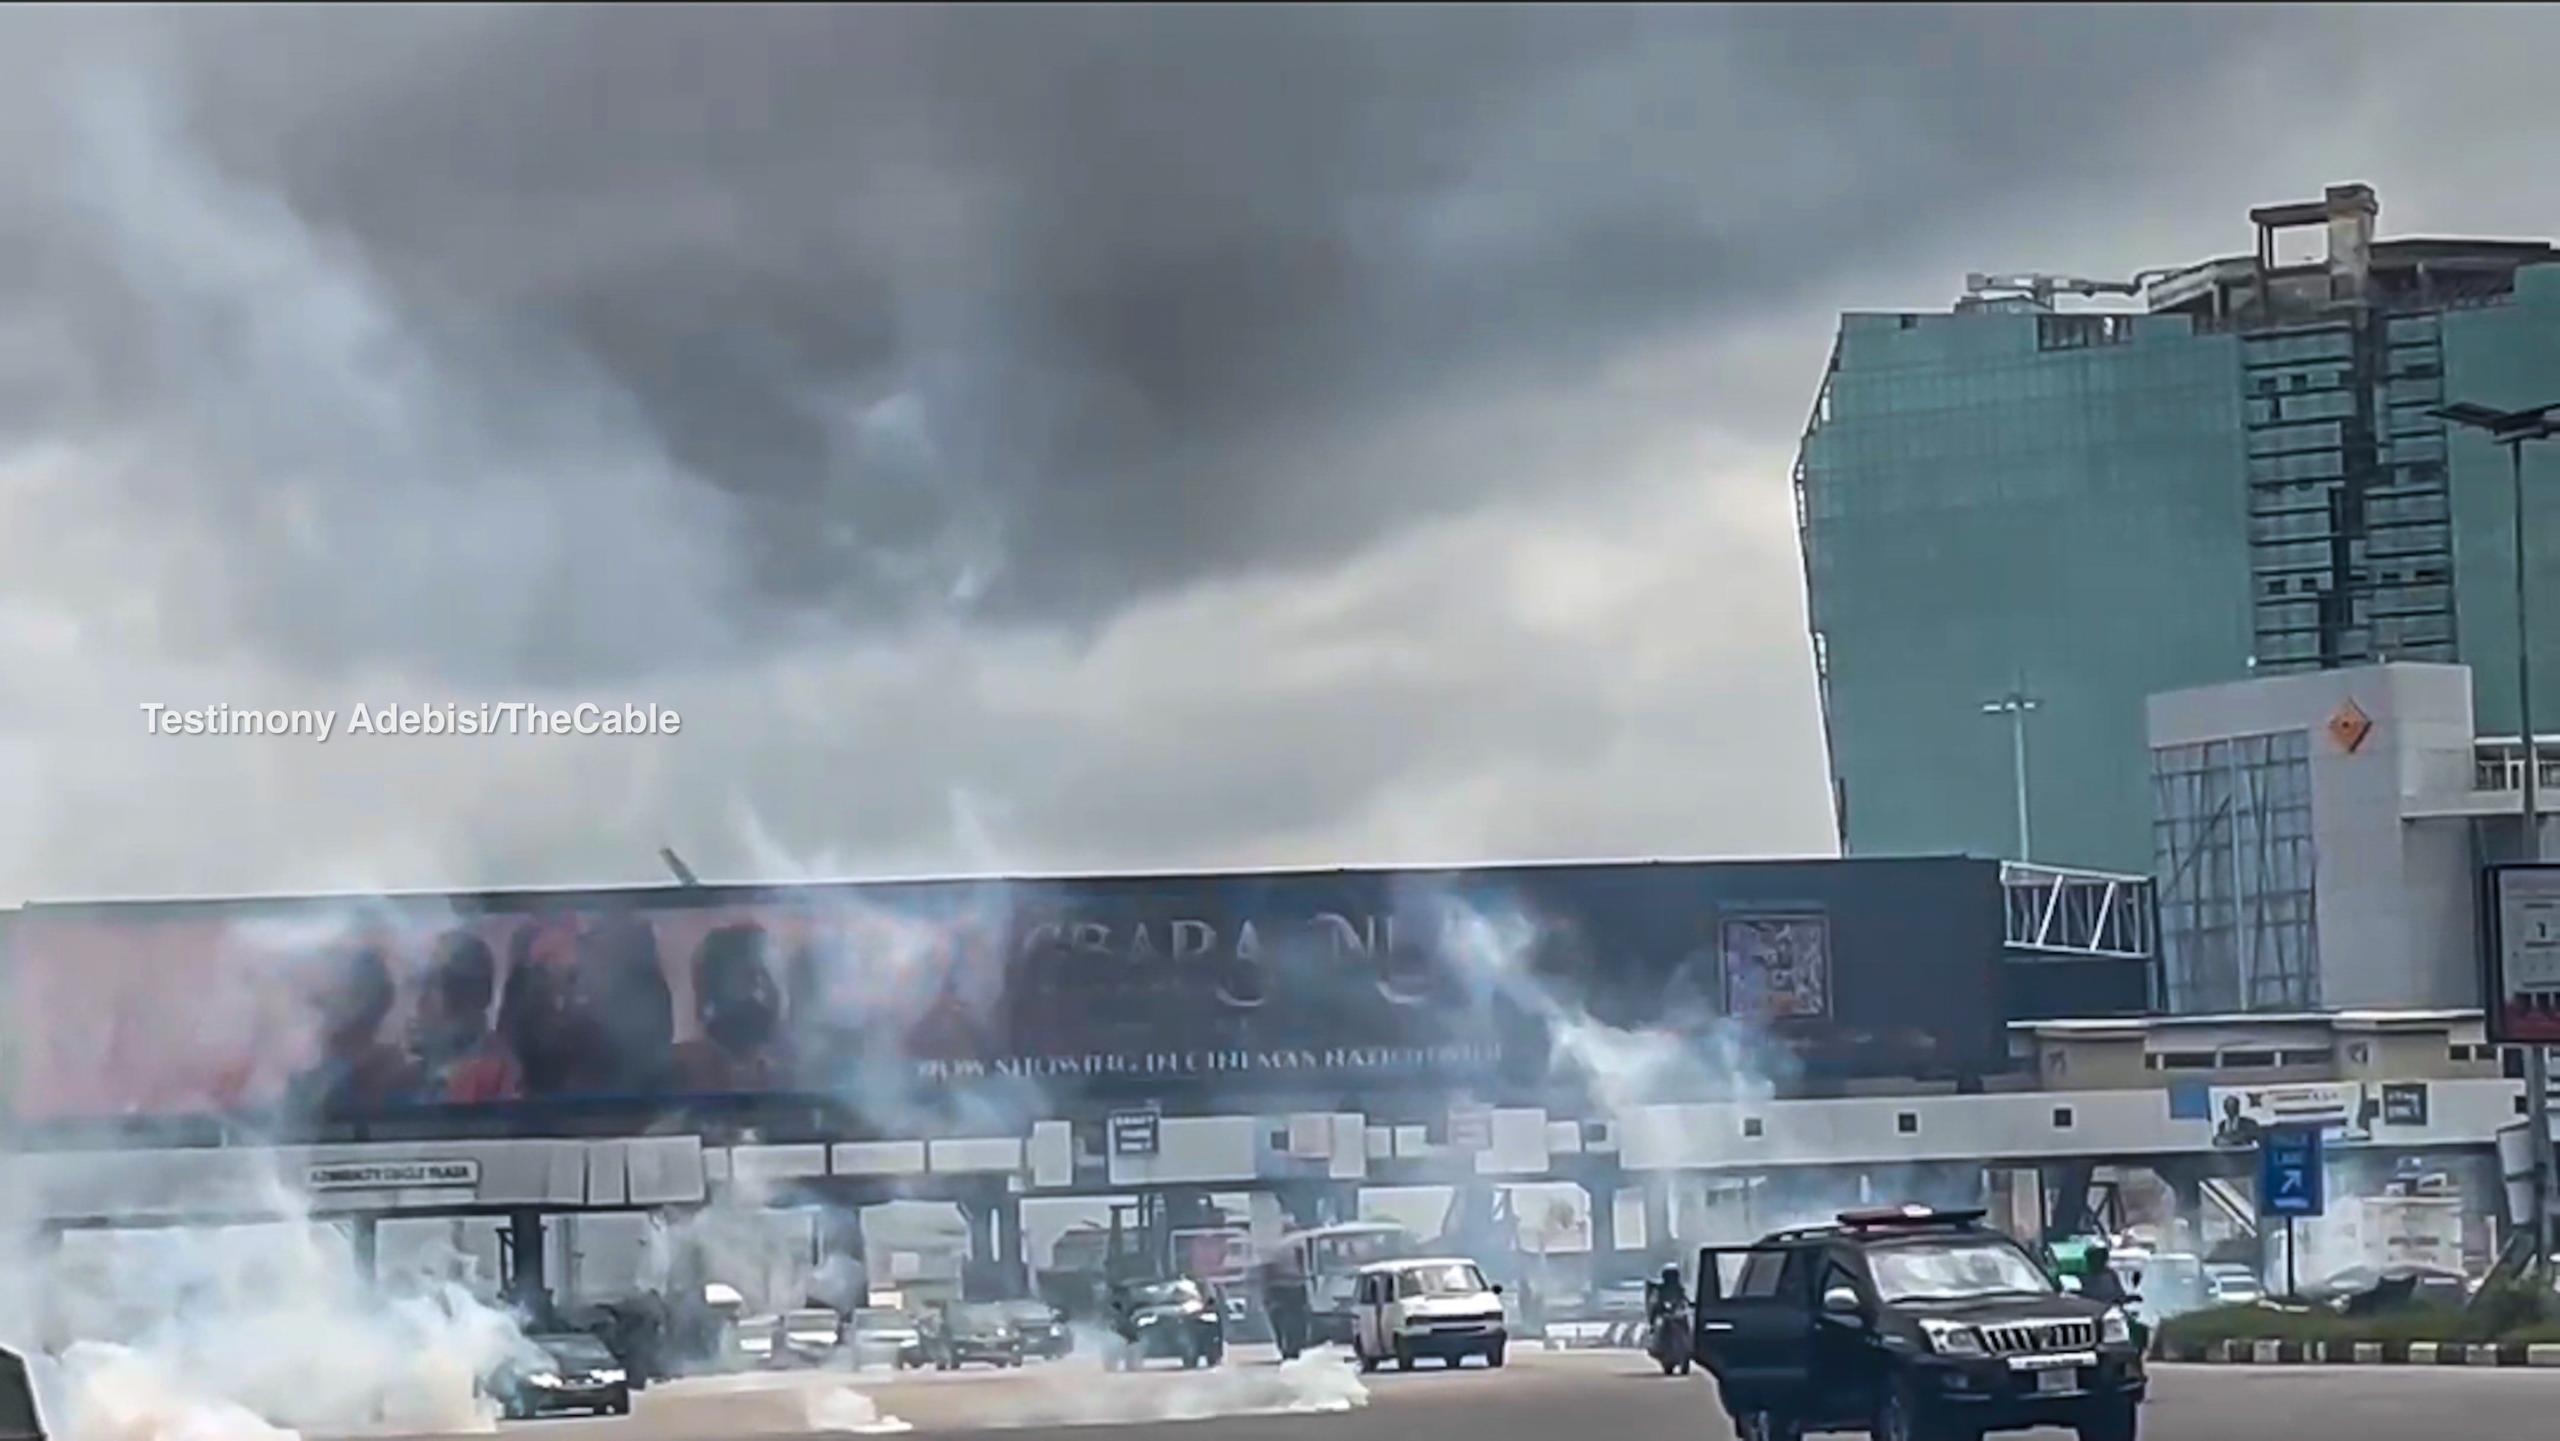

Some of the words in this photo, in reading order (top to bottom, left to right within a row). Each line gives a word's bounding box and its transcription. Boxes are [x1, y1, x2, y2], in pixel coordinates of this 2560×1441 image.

[995, 1054, 1139, 1077] SHOWING
[1146, 1052, 1178, 1073] IN
[1185, 1049, 1318, 1072] CINEMAS
